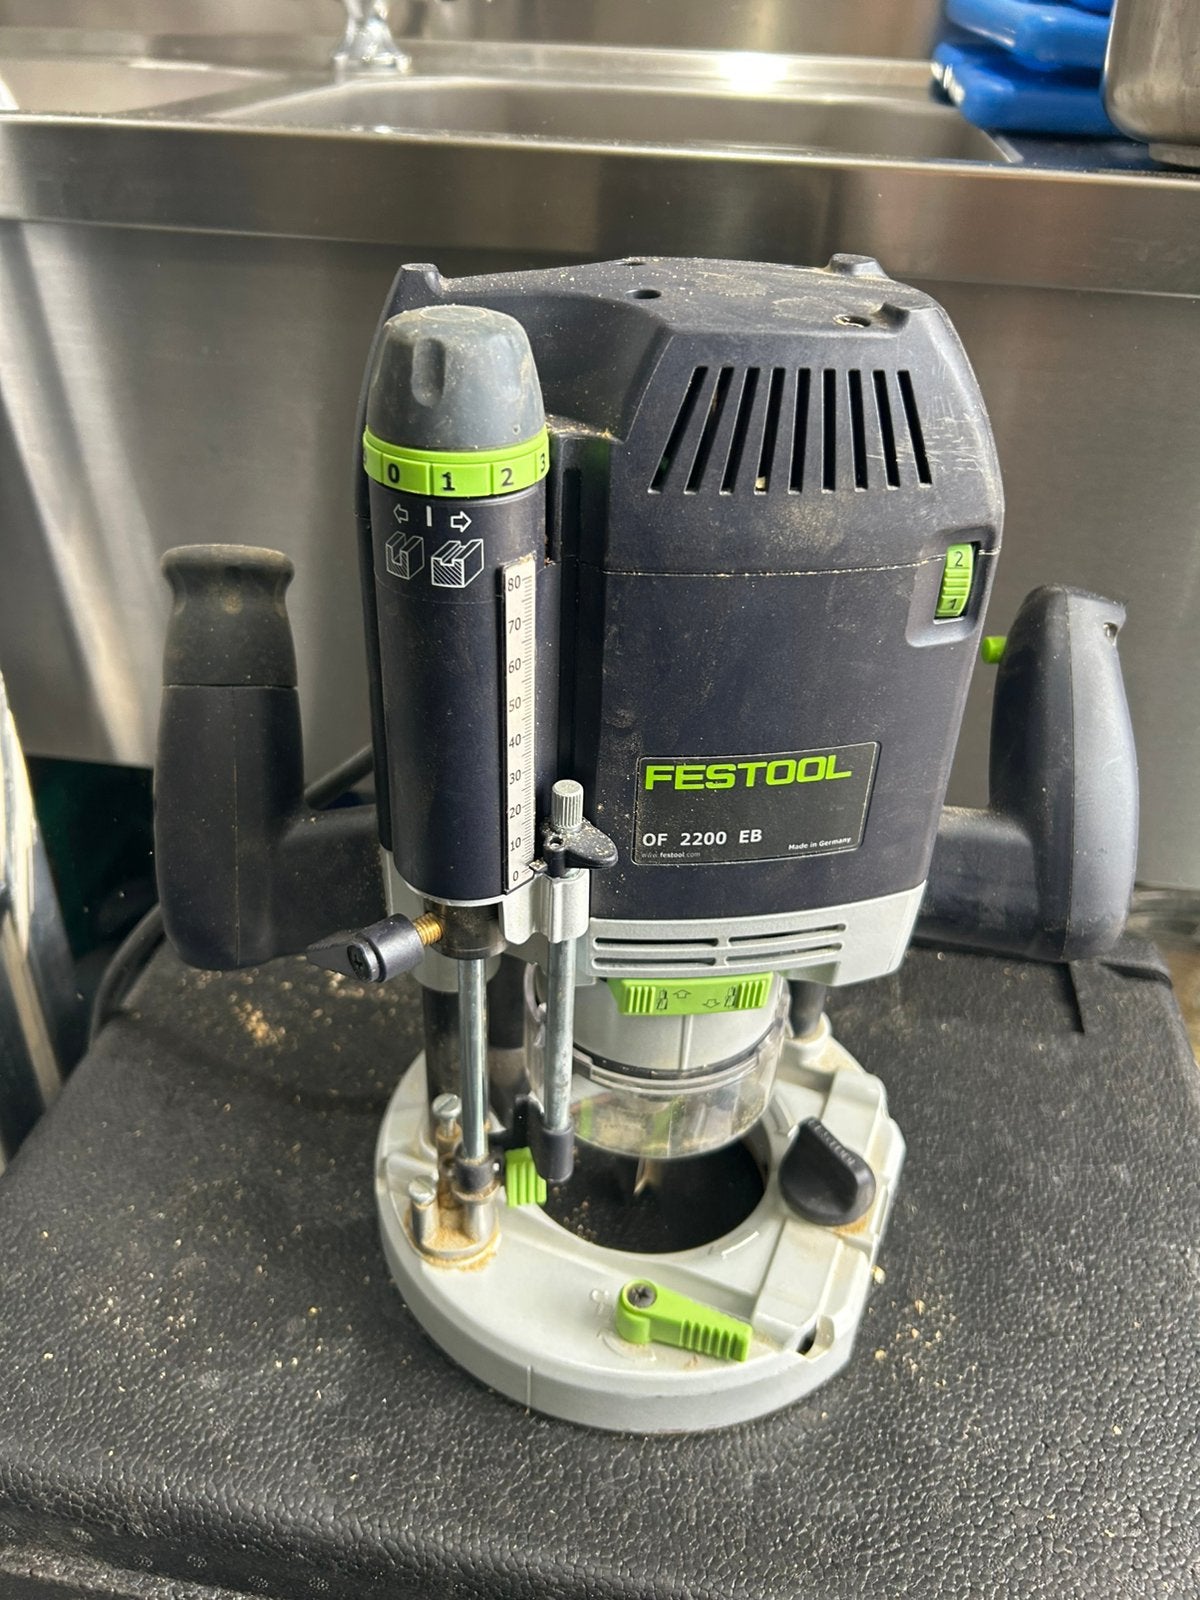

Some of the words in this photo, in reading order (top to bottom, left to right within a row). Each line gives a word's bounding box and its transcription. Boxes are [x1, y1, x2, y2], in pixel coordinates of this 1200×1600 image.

[387, 462, 400, 484] 0
[441, 471, 456, 492] 1
[500, 466, 514, 487] 2
[954, 550, 964, 568] 2
[507, 574, 521, 592] 80
[949, 597, 958, 610] 1
[507, 617, 521, 634] 70
[508, 657, 521, 674] 60
[508, 696, 521, 713] 50
[508, 733, 521, 749] 40
[509, 769, 521, 785] 30
[645, 754, 852, 791] FESTOOL
[509, 803, 521, 819] 20
[510, 836, 521, 852] 10
[642, 833, 668, 848] OF
[680, 831, 727, 847] 2200
[738, 828, 763, 844] EB
[788, 842, 808, 851] Made
[818, 836, 852, 848] Germany
[512, 870, 519, 882] 0
